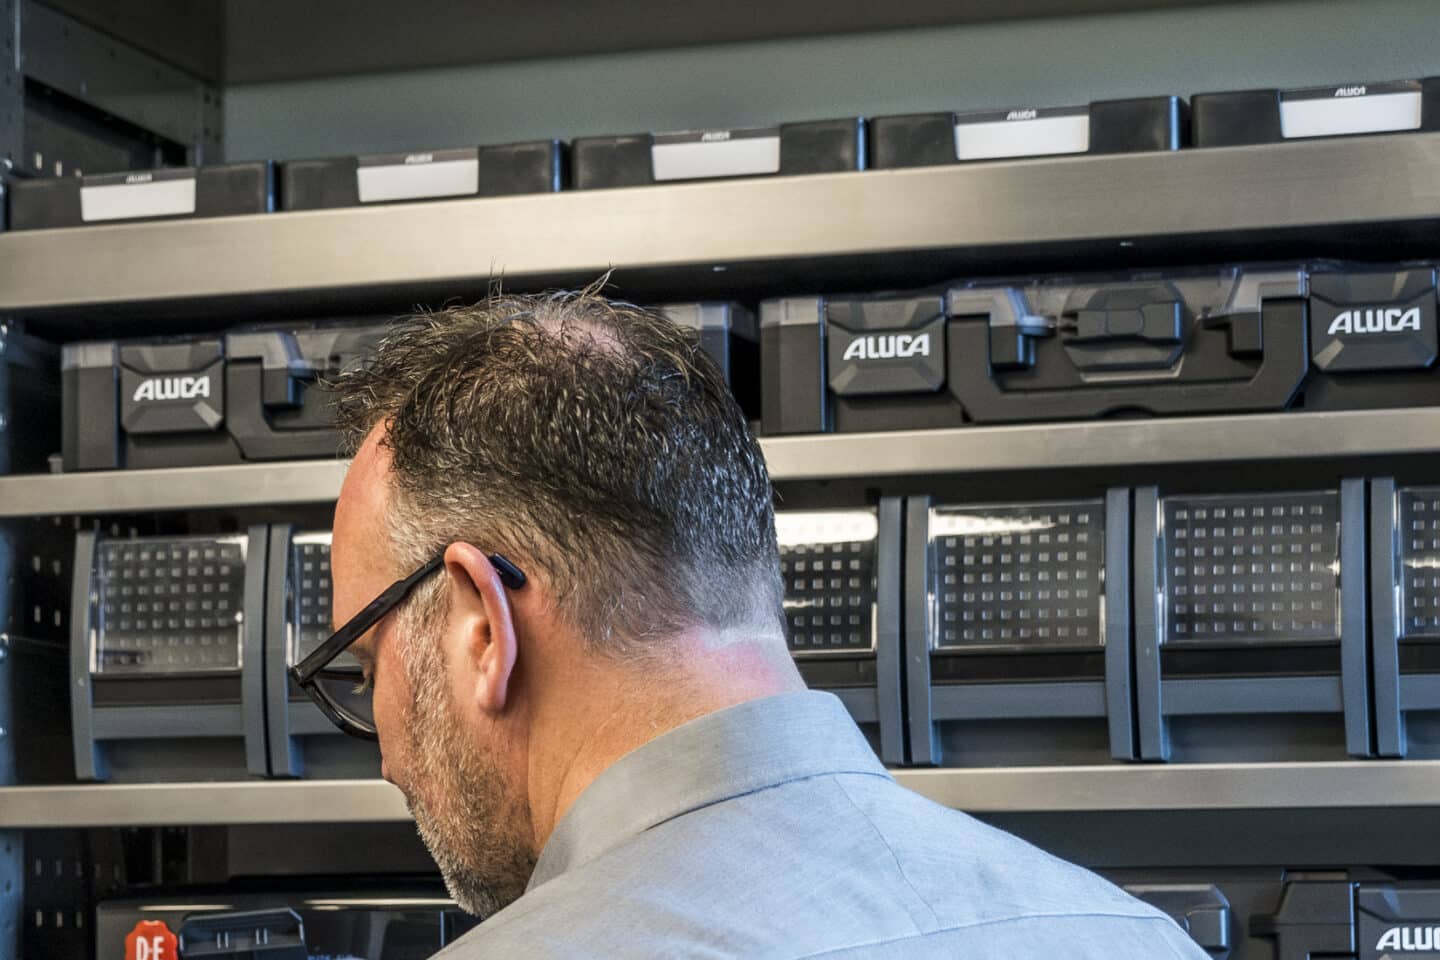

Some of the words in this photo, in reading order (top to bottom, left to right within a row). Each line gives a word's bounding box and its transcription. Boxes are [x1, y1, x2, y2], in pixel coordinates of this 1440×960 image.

[1327, 307, 1421, 335] ALUCA
[843, 333, 930, 361] ALUCA
[133, 375, 210, 402] ALUCA
